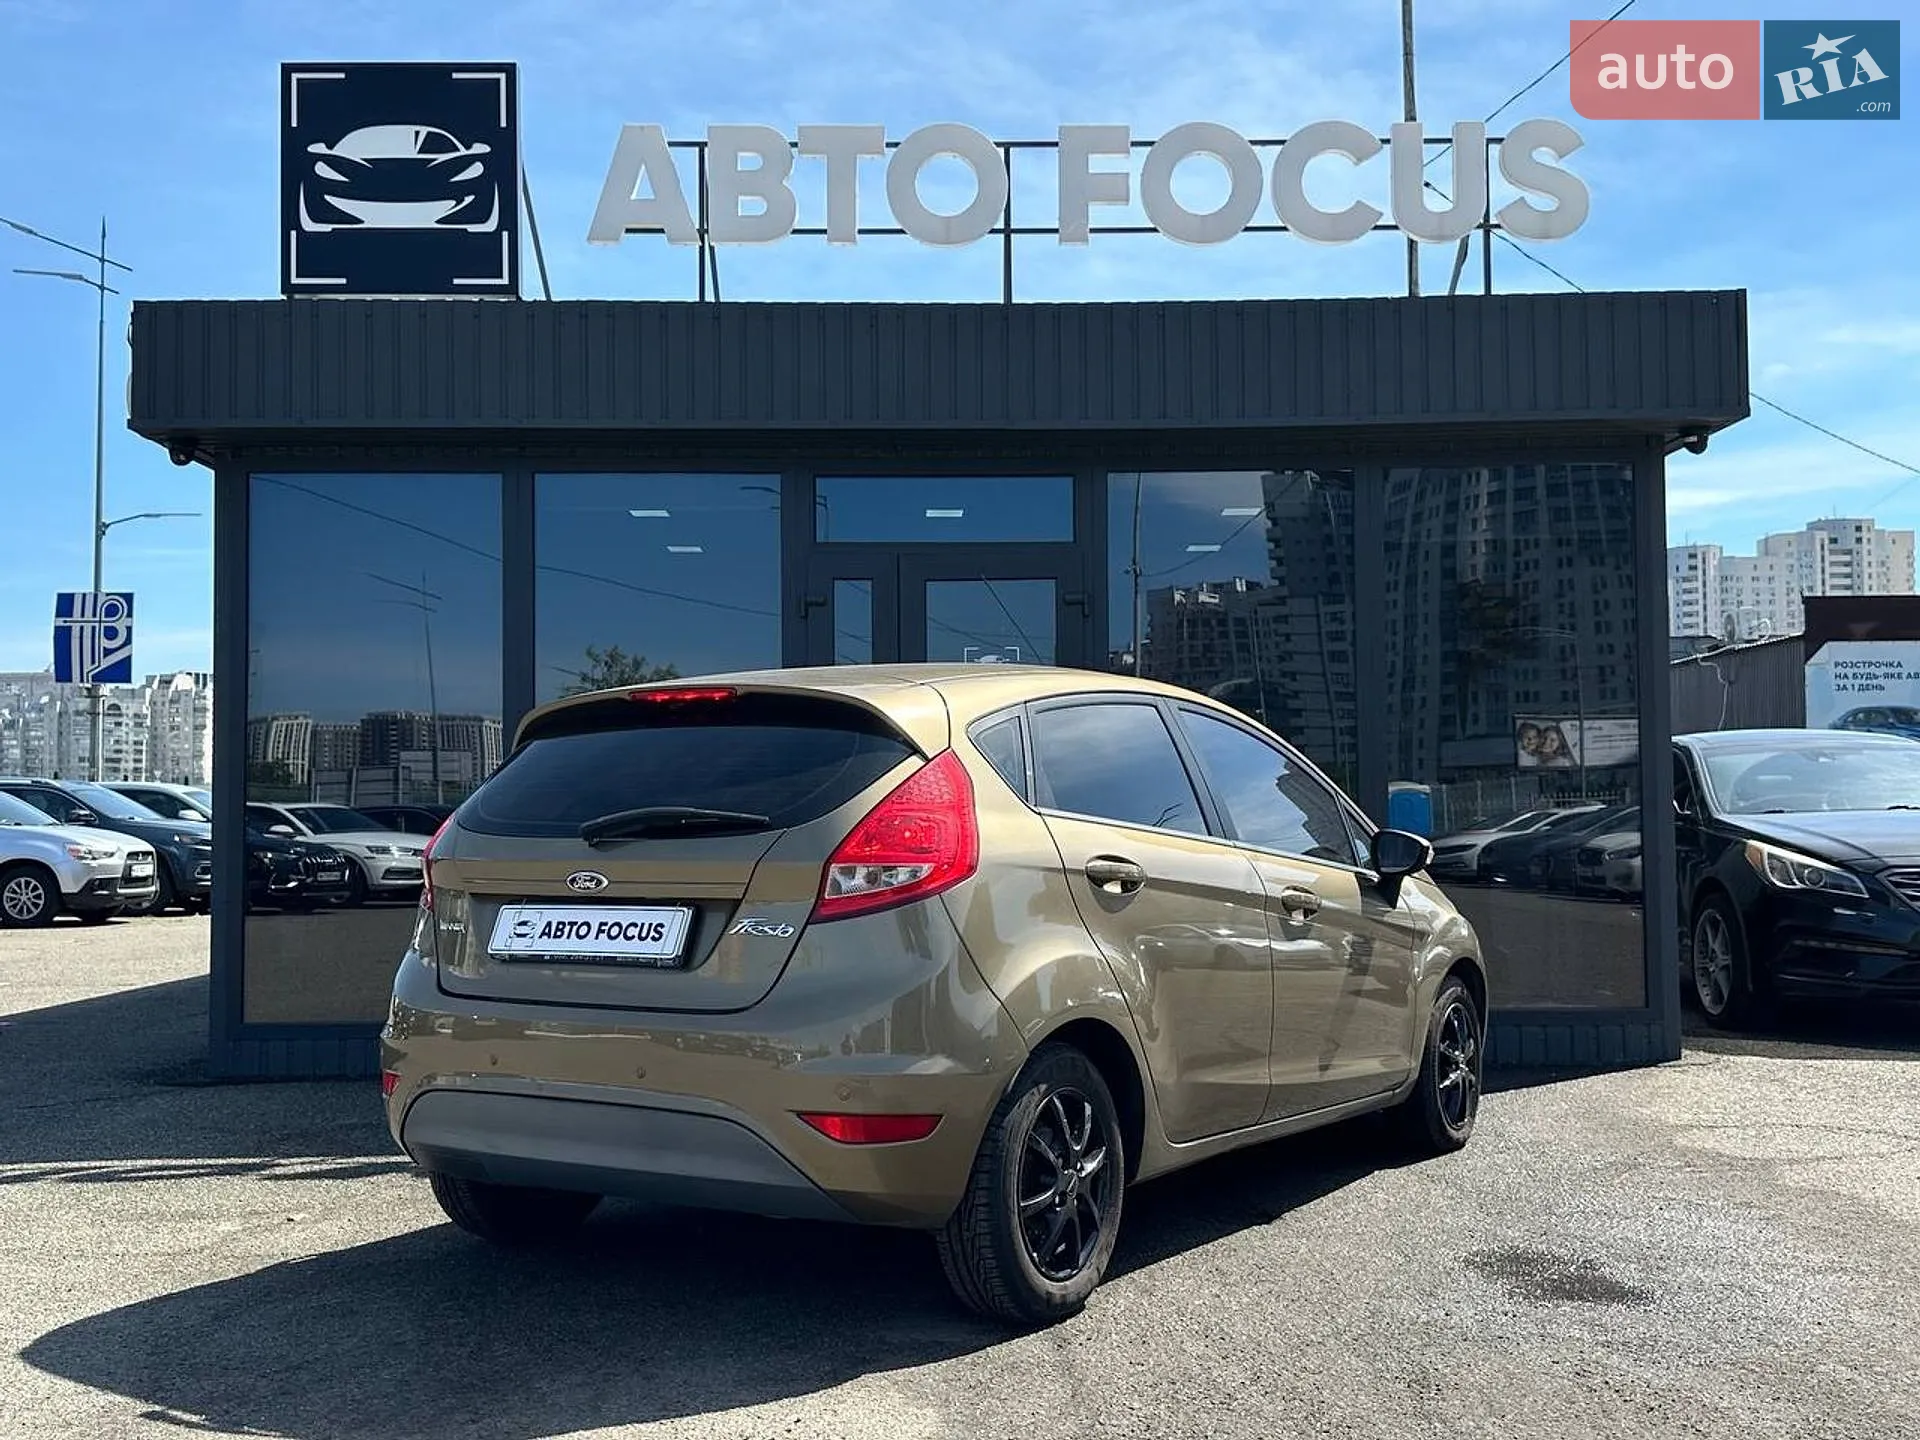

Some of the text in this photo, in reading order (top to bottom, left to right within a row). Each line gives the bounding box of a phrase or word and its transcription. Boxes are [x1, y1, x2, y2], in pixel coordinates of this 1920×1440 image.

[587, 118, 1591, 246] АВТО FOCUS
[1834, 661, 1903, 669] РОЗСТРОЧКА
[1834, 672, 1920, 681] НА БУДЬ-ЯКЕ АВ
[1858, 684, 1885, 692] ДЕНЬ
[573, 875, 597, 888] Ford
[539, 920, 665, 942] АВТО FOCUS
[728, 918, 795, 937] Fiesta
